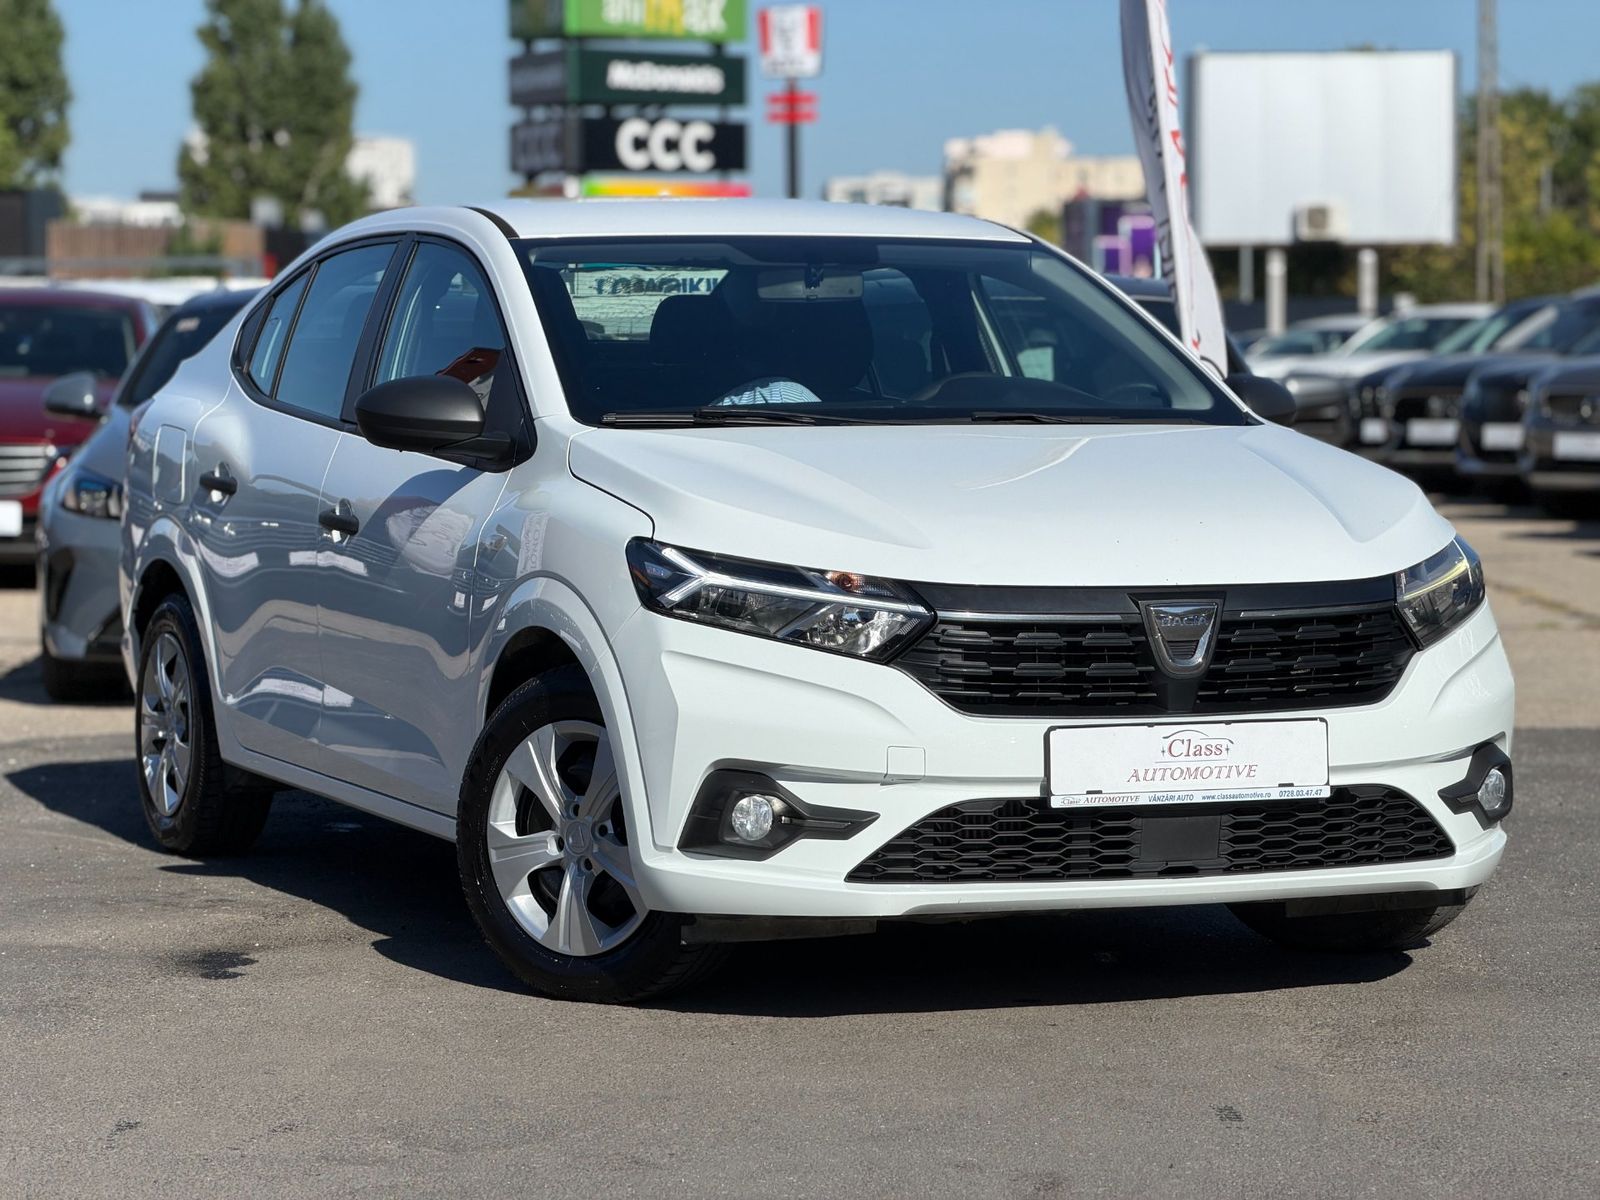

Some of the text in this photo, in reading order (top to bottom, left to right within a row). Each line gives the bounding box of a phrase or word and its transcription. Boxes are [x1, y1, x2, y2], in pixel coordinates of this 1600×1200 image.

[616, 119, 716, 172] CCC
[1168, 739, 1223, 757] Class
[1127, 765, 1258, 781] AUTOMOTIVE
[1084, 795, 1140, 804] AUTOMOTIVE
[1177, 793, 1194, 802] AUTO
[1202, 791, 1271, 801] www.classautomotive.ro
[1279, 789, 1322, 797] 0728.03.47.47
